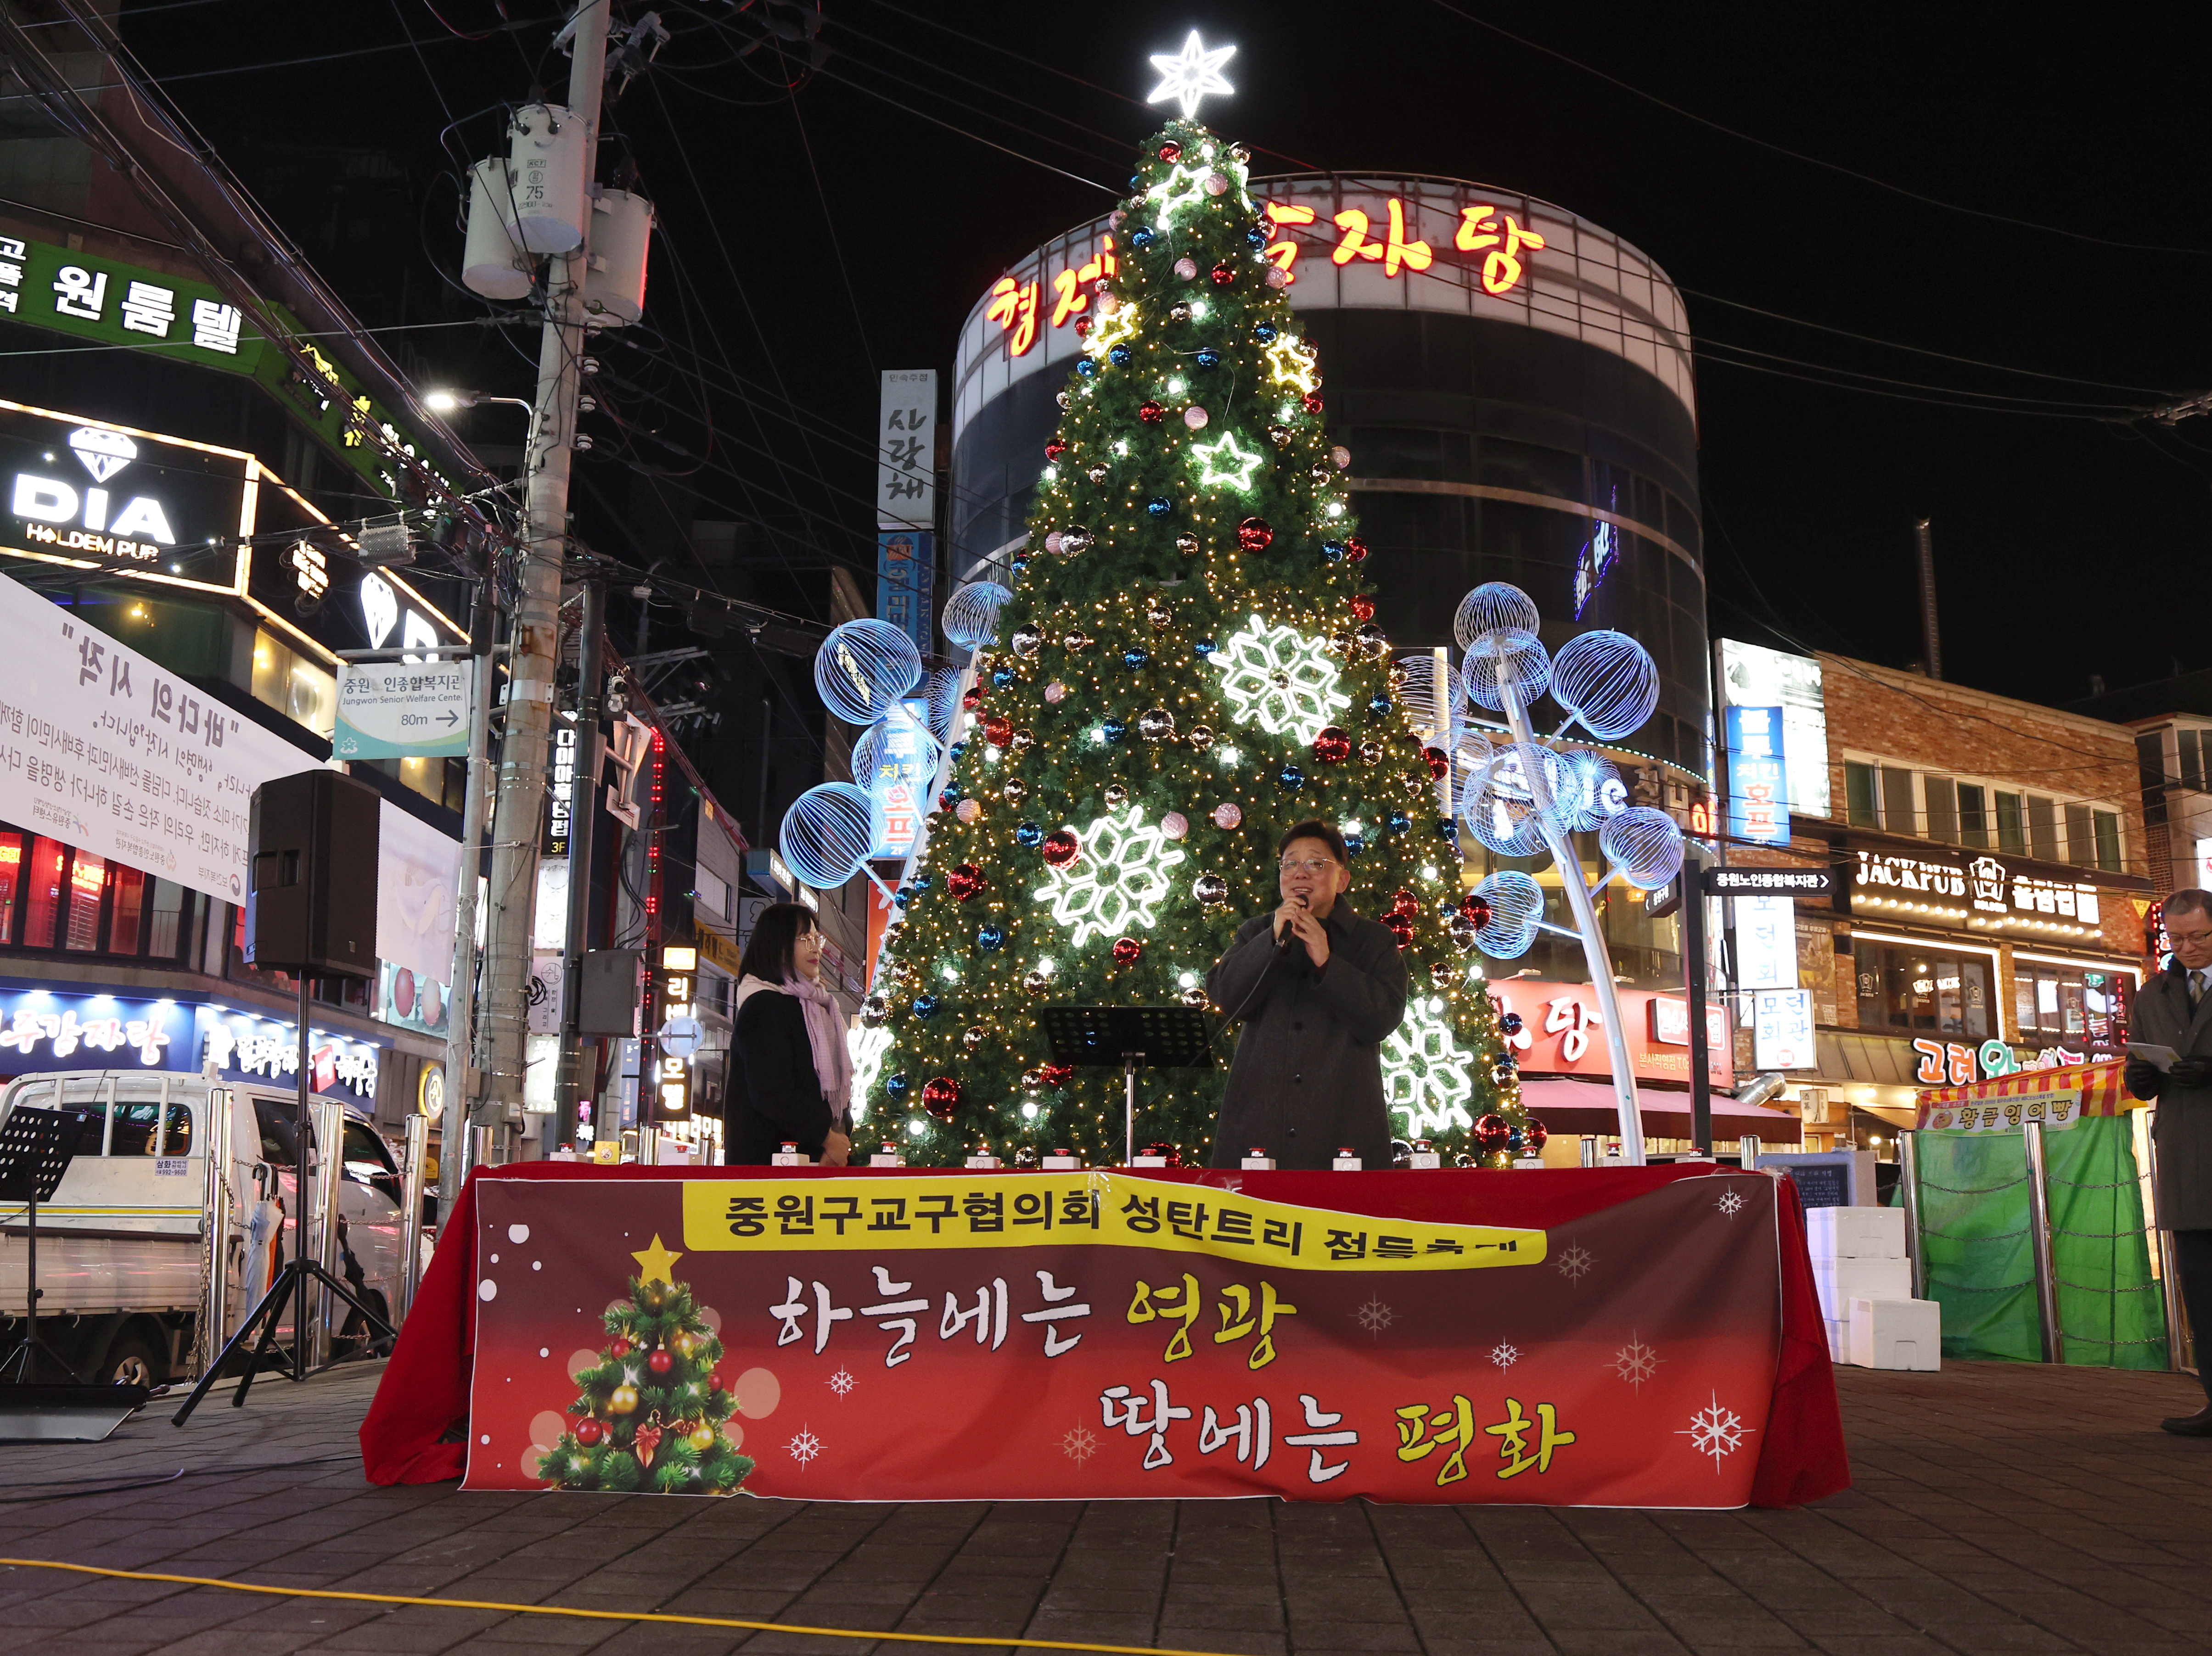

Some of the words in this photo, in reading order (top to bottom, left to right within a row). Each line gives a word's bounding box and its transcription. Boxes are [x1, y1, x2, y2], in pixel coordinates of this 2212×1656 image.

[526, 186, 544, 200] 75
[53, 266, 242, 354] 원룸텔
[889, 373, 928, 383] 민속주점
[886, 408, 927, 500] 사랑채
[13, 473, 176, 545] DIA
[344, 675, 460, 694] 중원인종합복지관
[342, 696, 377, 705] Jungwon
[380, 695, 404, 704] Senior
[406, 694, 436, 703] Welfare
[438, 694, 463, 702] Cente
[401, 715, 428, 726] 80m
[1736, 762, 1780, 780] 치킨
[1742, 781, 1778, 834] 호프
[551, 842, 566, 853] 3F
[890, 845, 906, 855] 2F
[1716, 873, 1819, 888] 중원노인종합복지관
[1761, 1019, 1809, 1042] 회관
[1639, 1052, 1676, 1071] 본사직영점
[1959, 1099, 2074, 1130] 황금잉어빵
[157, 1160, 171, 1169] 삼화
[724, 1187, 1101, 1237] 중원구교구협의회
[1122, 1191, 1304, 1258] 성탄트리
[768, 1264, 1092, 1368] 하늘에는
[1126, 1272, 1298, 1371] 영광
[1099, 1378, 1359, 1483] 땅에는
[1394, 1393, 1575, 1486] 평화
